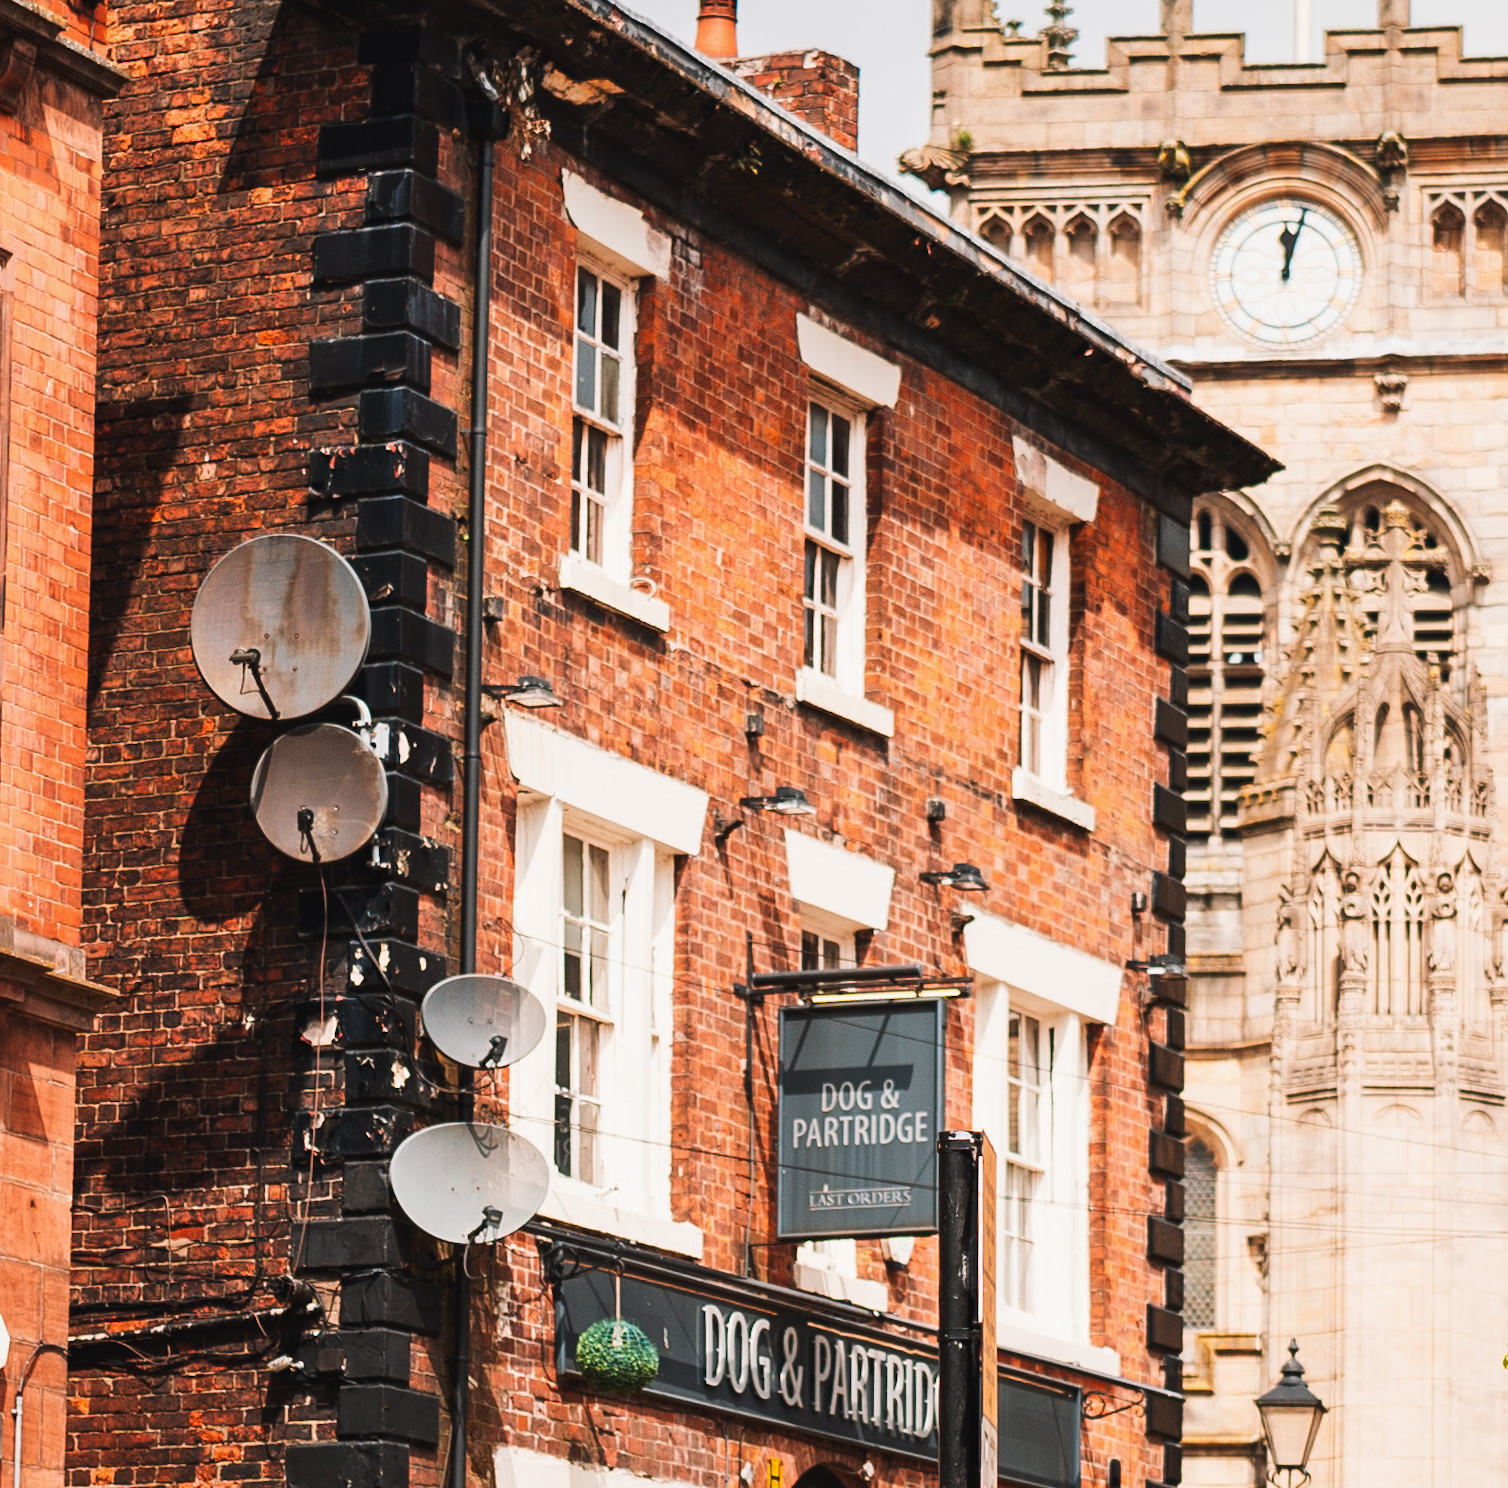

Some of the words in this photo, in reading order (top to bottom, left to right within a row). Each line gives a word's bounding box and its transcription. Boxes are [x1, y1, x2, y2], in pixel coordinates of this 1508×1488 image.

[821, 1080, 873, 1112] DOG
[880, 1079, 900, 1109] &
[793, 1112, 929, 1149] PARTRIDGE
[809, 1193, 843, 1207] LAST
[847, 1191, 912, 1205] ORDERS
[702, 1304, 771, 1400] DOG
[778, 1326, 803, 1408] &
[813, 1334, 941, 1439] PARTRID
